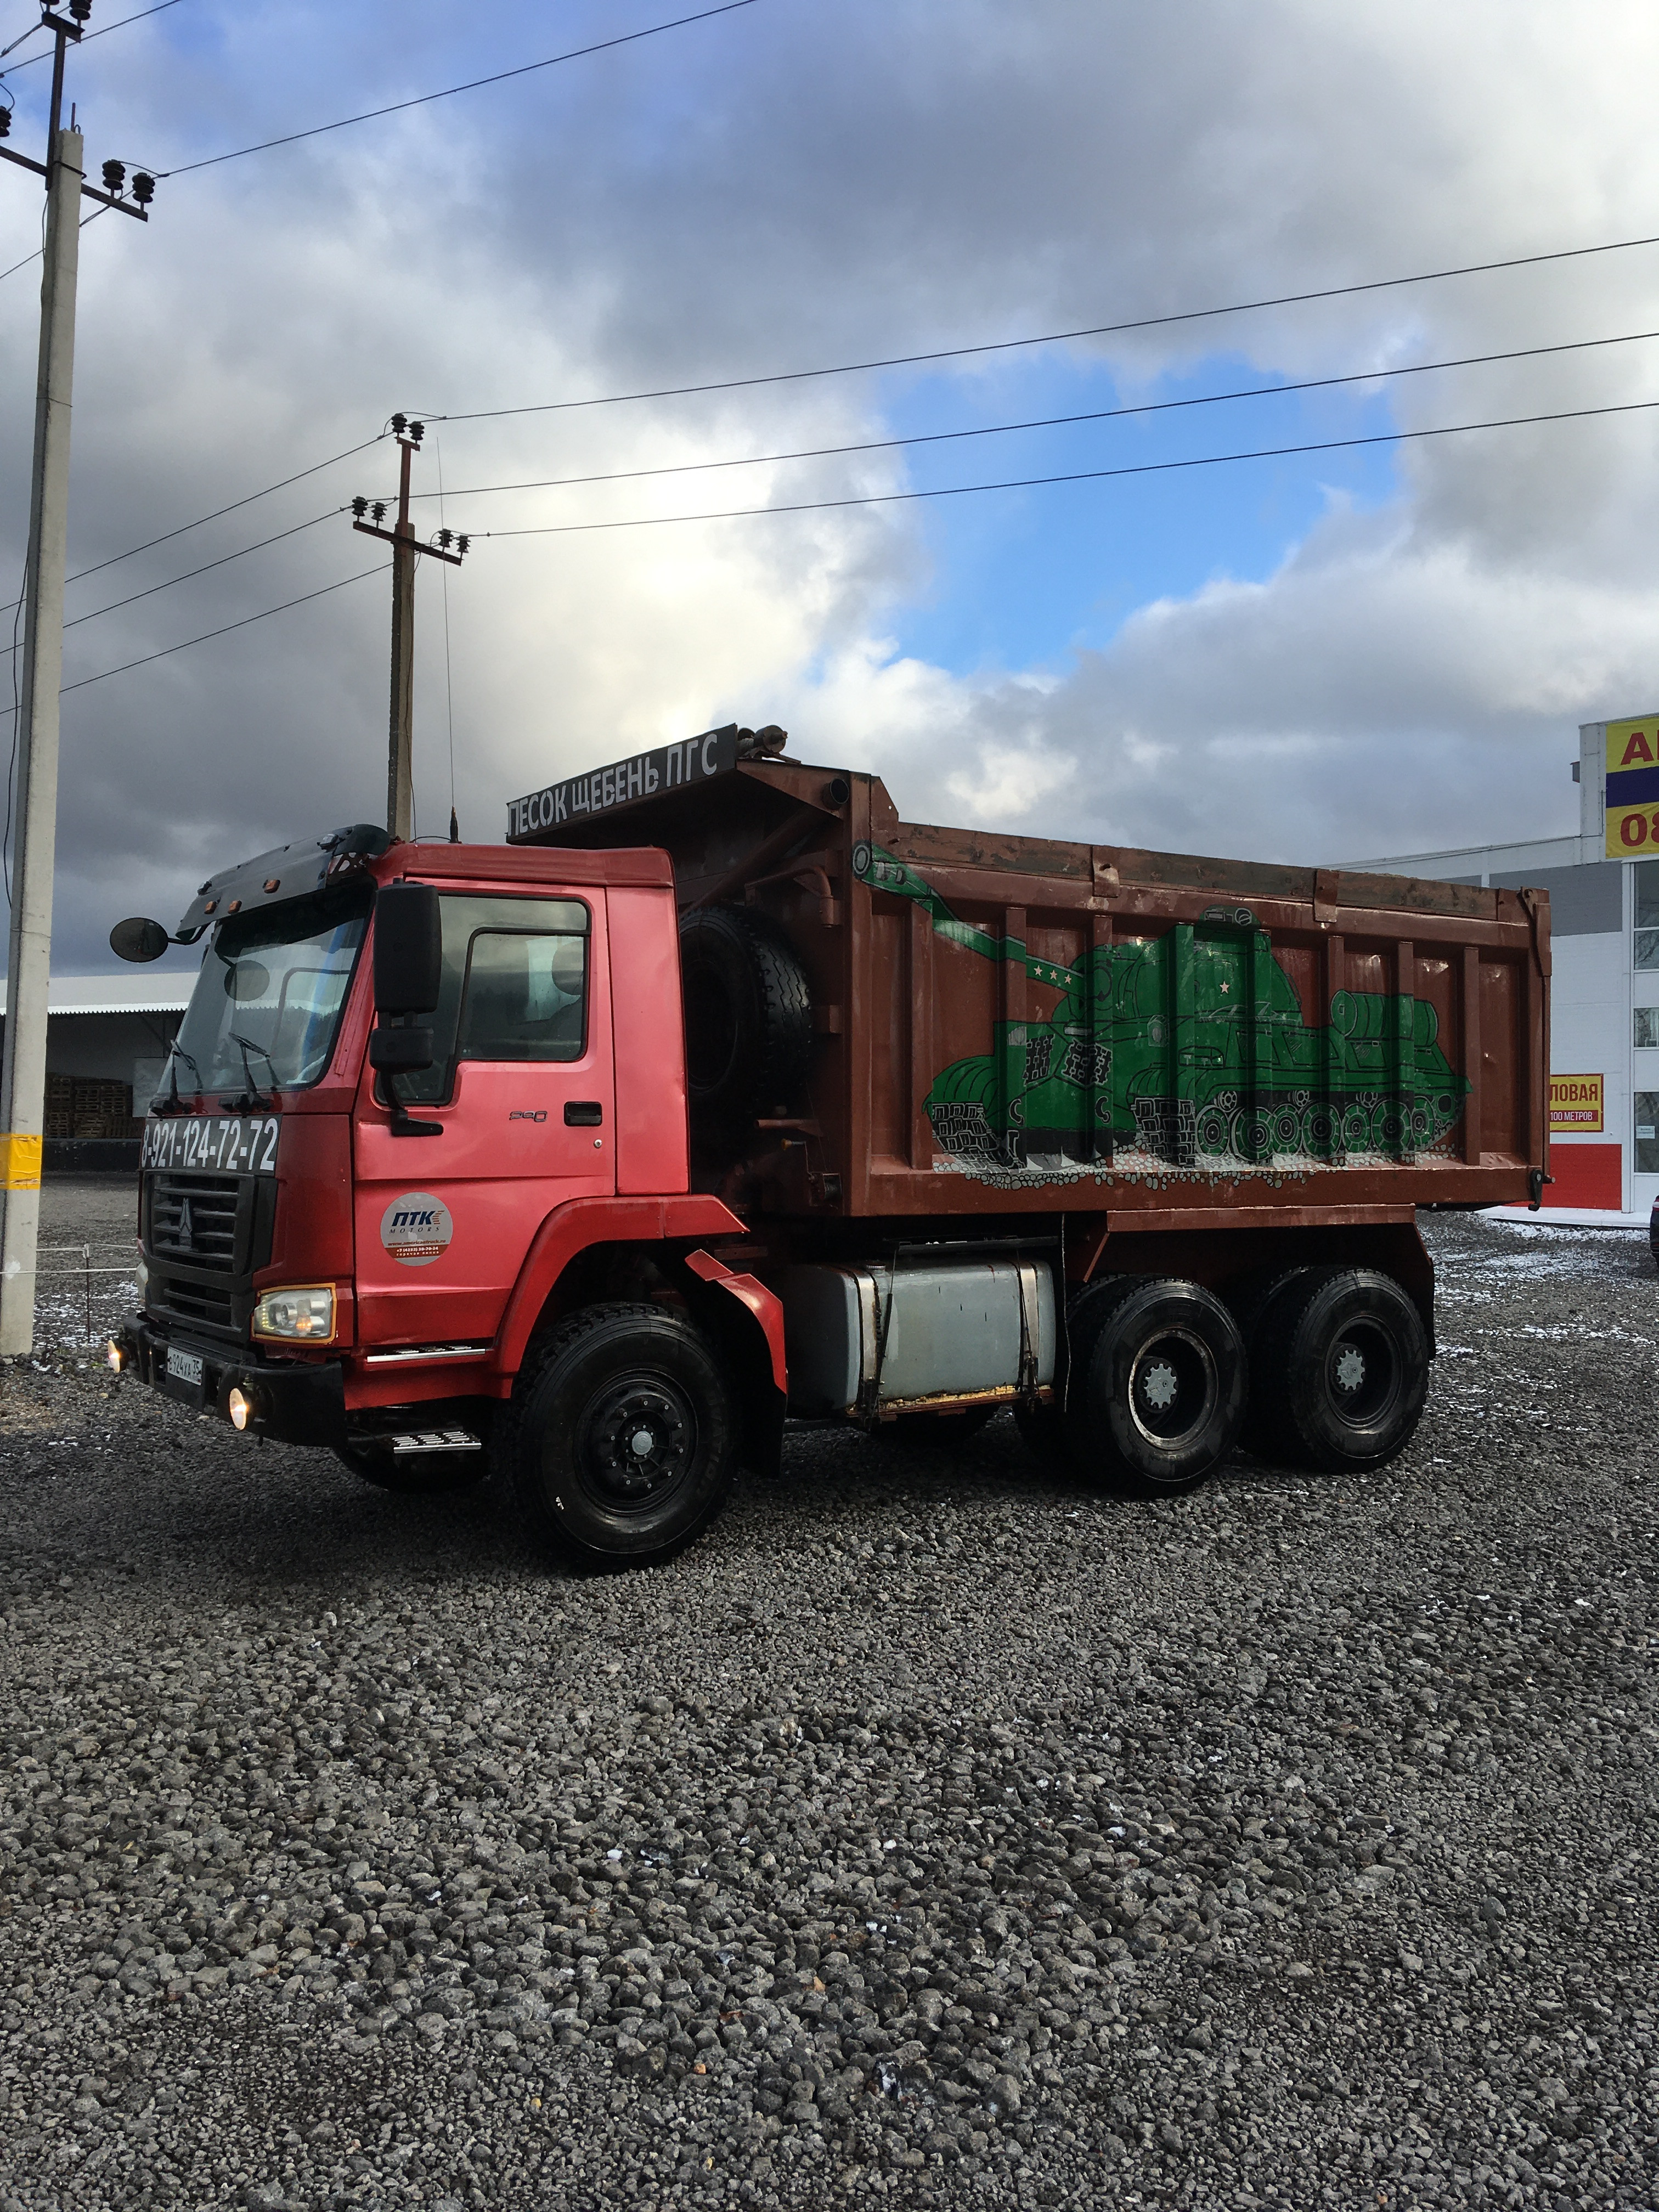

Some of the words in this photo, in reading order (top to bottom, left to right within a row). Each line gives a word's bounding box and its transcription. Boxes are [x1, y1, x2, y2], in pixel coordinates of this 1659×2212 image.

[1620, 729, 1659, 765] А
[507, 785, 568, 837] ПЕСОК
[572, 756, 659, 812] ЩЕБЕНЬ
[665, 733, 718, 787] ПГС
[1550, 1112, 1563, 1121] 100
[1564, 1111, 1593, 1121] МЕТРОВ
[141, 1118, 278, 1171] 8-921-124-72-72
[391, 1210, 436, 1227] ПТК
